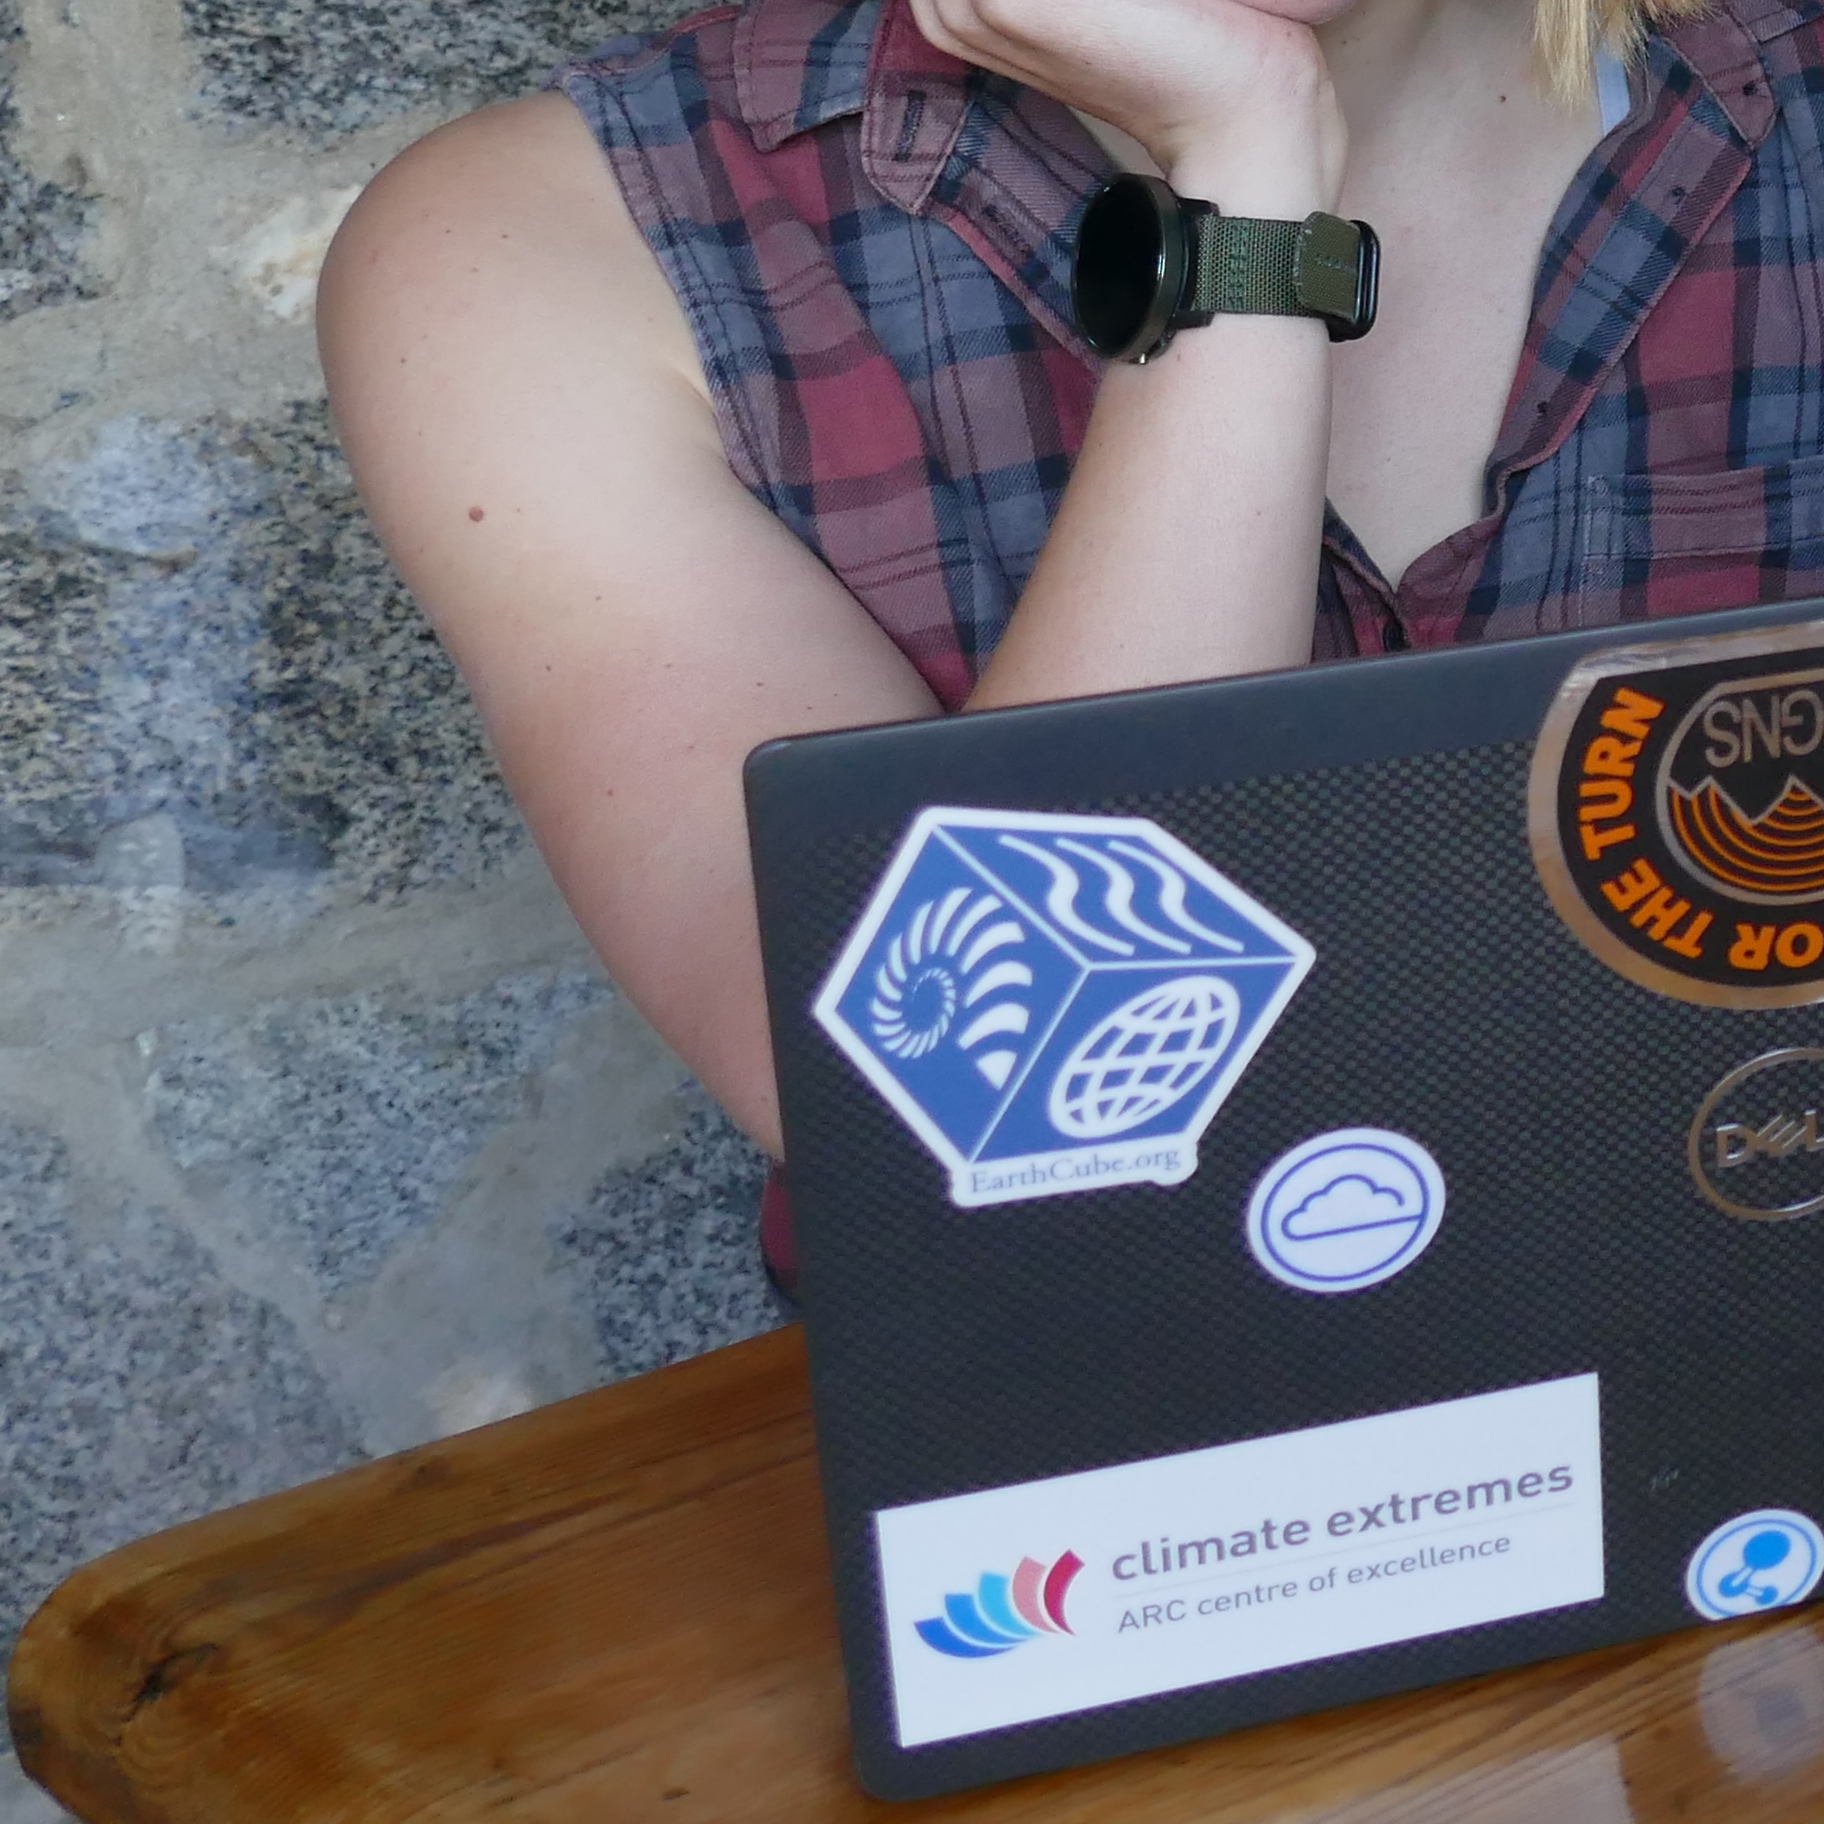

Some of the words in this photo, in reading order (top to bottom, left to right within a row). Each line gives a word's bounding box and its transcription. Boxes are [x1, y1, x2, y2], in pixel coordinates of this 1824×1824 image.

[1576, 686, 1666, 862] TURN
[1601, 856, 1715, 960] THE
[970, 1150, 1181, 1194] EarthCube.org
[1111, 1516, 1311, 1582] climate
[1325, 1463, 1574, 1539] extremes
[1117, 1598, 1188, 1634] ARC
[1197, 1580, 1299, 1616] centre
[1307, 1566, 1339, 1593] of
[1346, 1533, 1512, 1585] excellence
